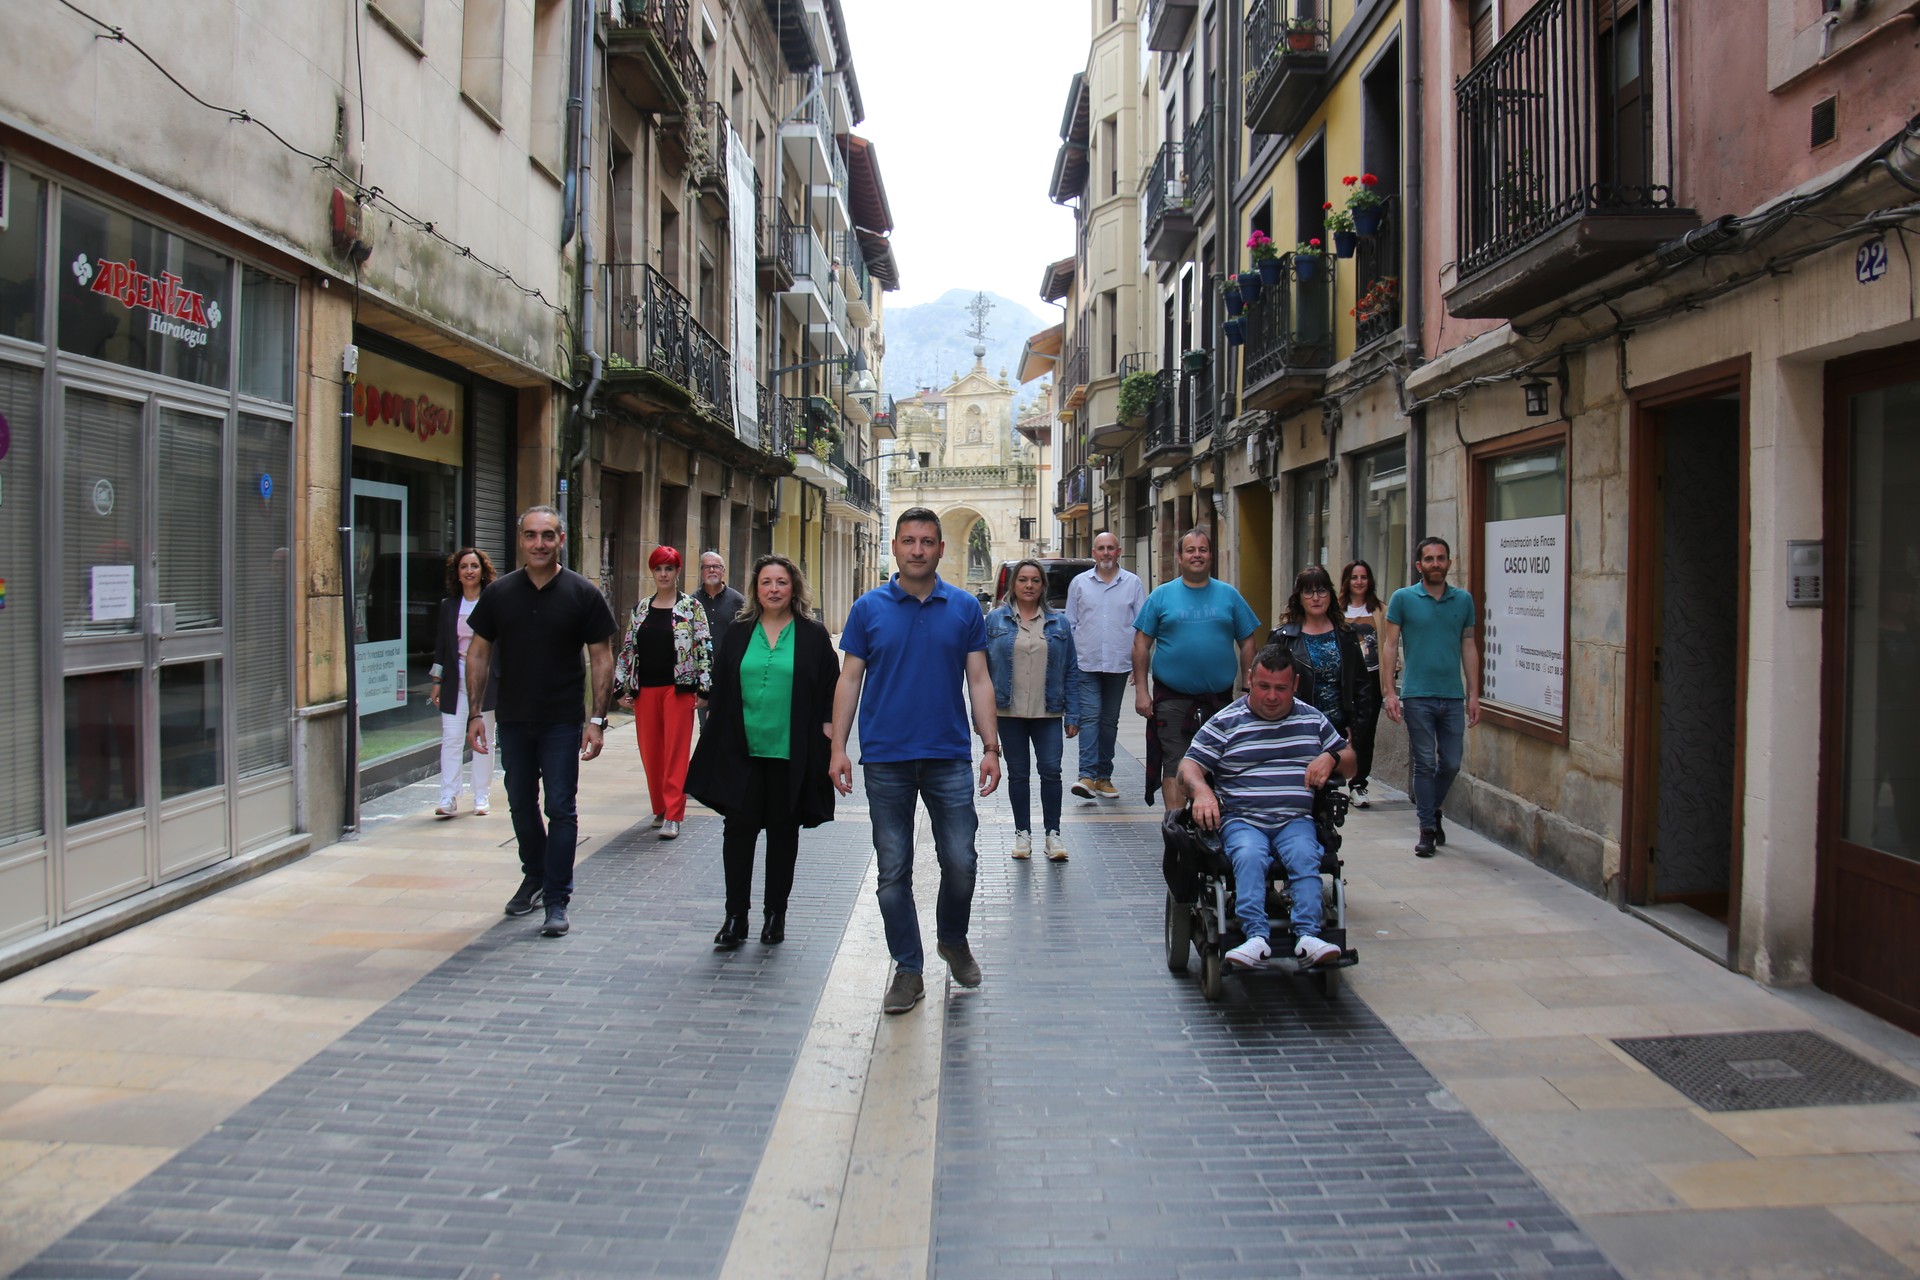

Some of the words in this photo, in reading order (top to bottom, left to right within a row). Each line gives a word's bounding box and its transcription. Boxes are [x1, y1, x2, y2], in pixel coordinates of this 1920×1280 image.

[1858, 241, 1886, 280] 22
[149, 312, 207, 348] Harategia
[1500, 536, 1532, 548] Administración
[1533, 535, 1539, 547] de
[1540, 535, 1556, 546] Fincas
[1504, 557, 1528, 574] CASCO
[1529, 556, 1550, 574] VIEJO
[1509, 587, 1525, 598] Gestión
[1526, 588, 1544, 602] integral
[1508, 604, 1514, 614] de
[1514, 605, 1545, 617] comunidades
